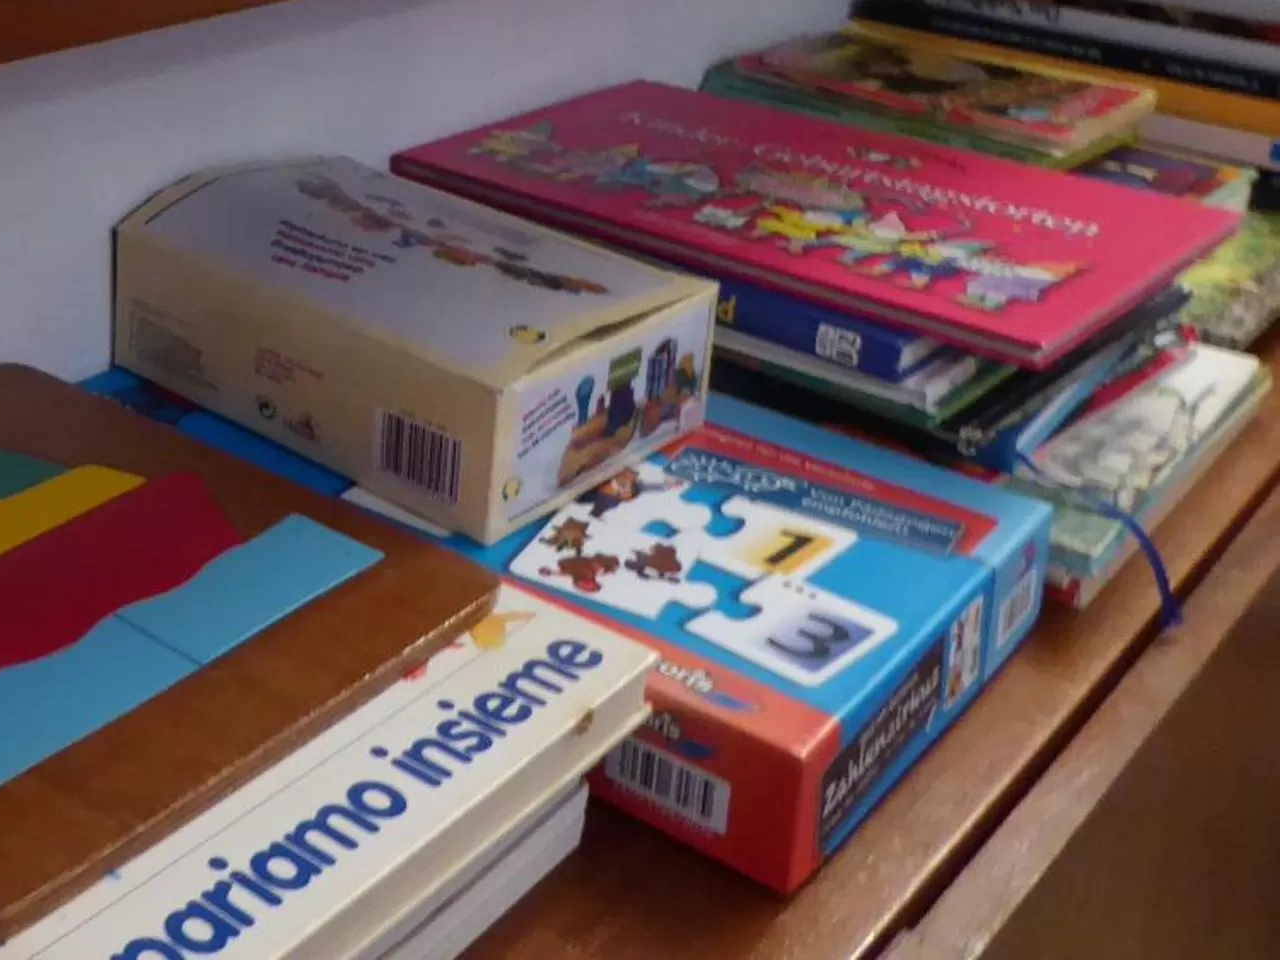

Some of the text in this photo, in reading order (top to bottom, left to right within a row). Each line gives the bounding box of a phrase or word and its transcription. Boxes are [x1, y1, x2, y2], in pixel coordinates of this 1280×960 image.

[765, 527, 817, 566] 1
[765, 612, 851, 661] 3
[371, 638, 604, 789] insieme
